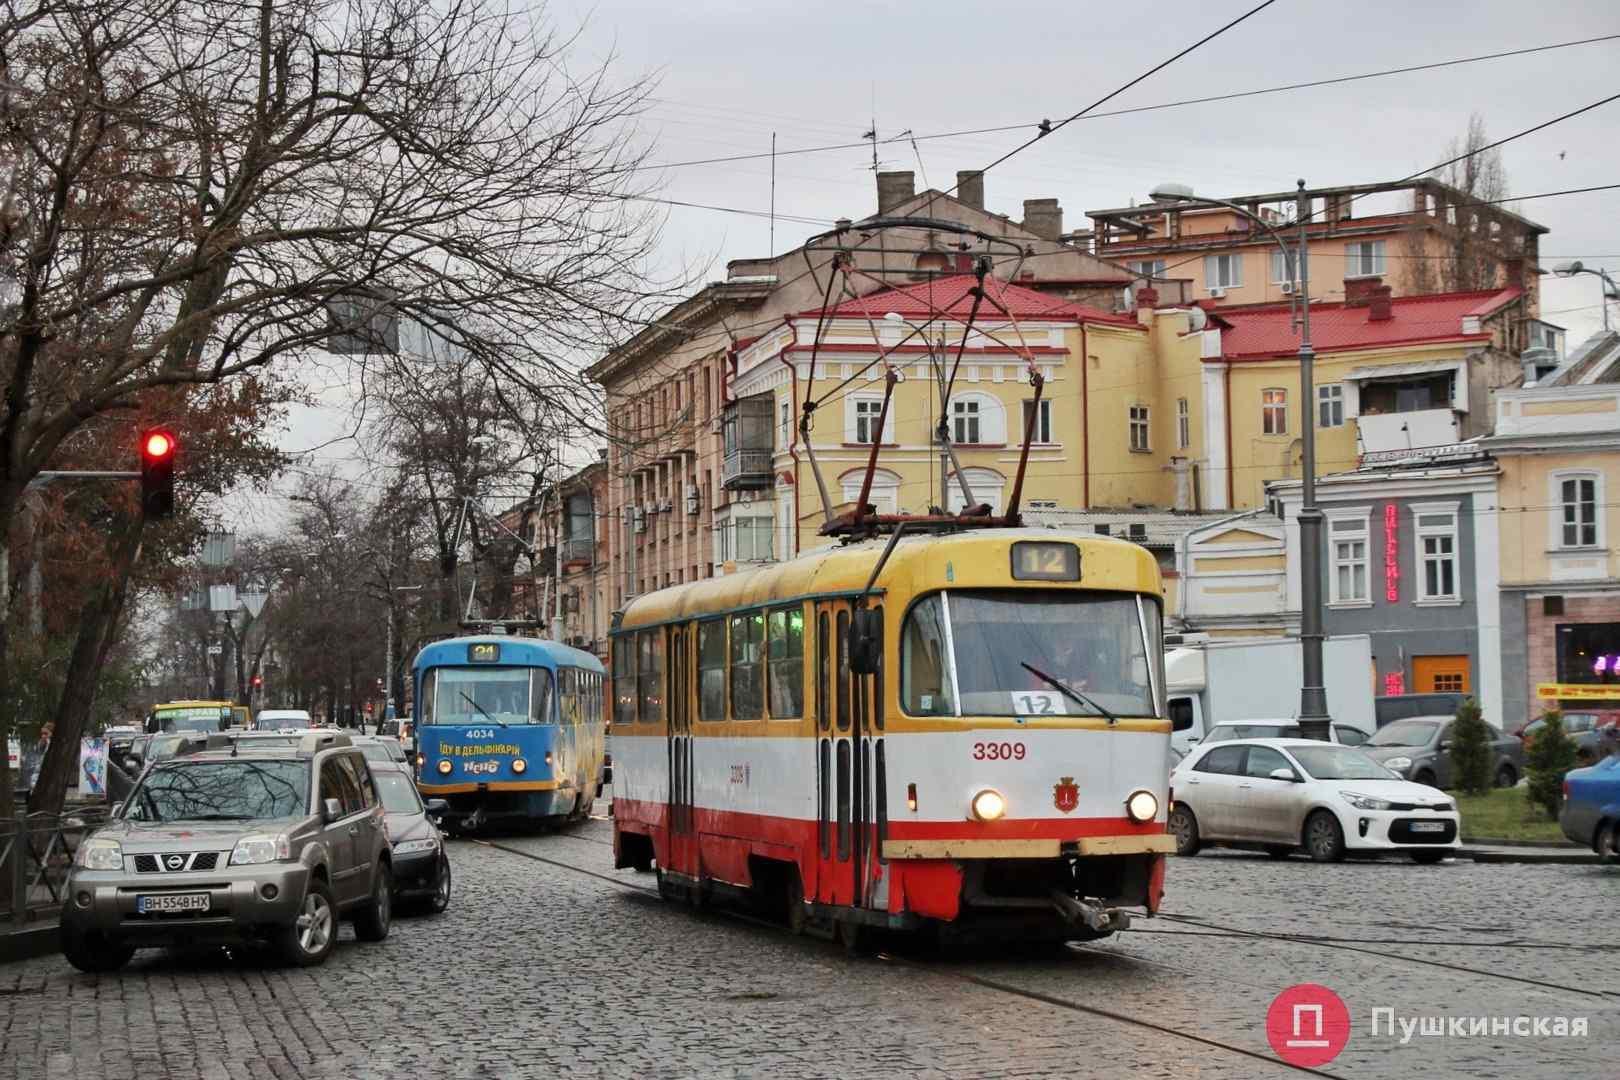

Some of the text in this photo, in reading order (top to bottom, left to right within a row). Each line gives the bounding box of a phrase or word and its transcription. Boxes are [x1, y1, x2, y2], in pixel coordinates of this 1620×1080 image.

[1023, 548, 1065, 573] 12
[1020, 696, 1055, 713] 12
[465, 729, 495, 739] 4034
[973, 742, 1026, 760] 3309
